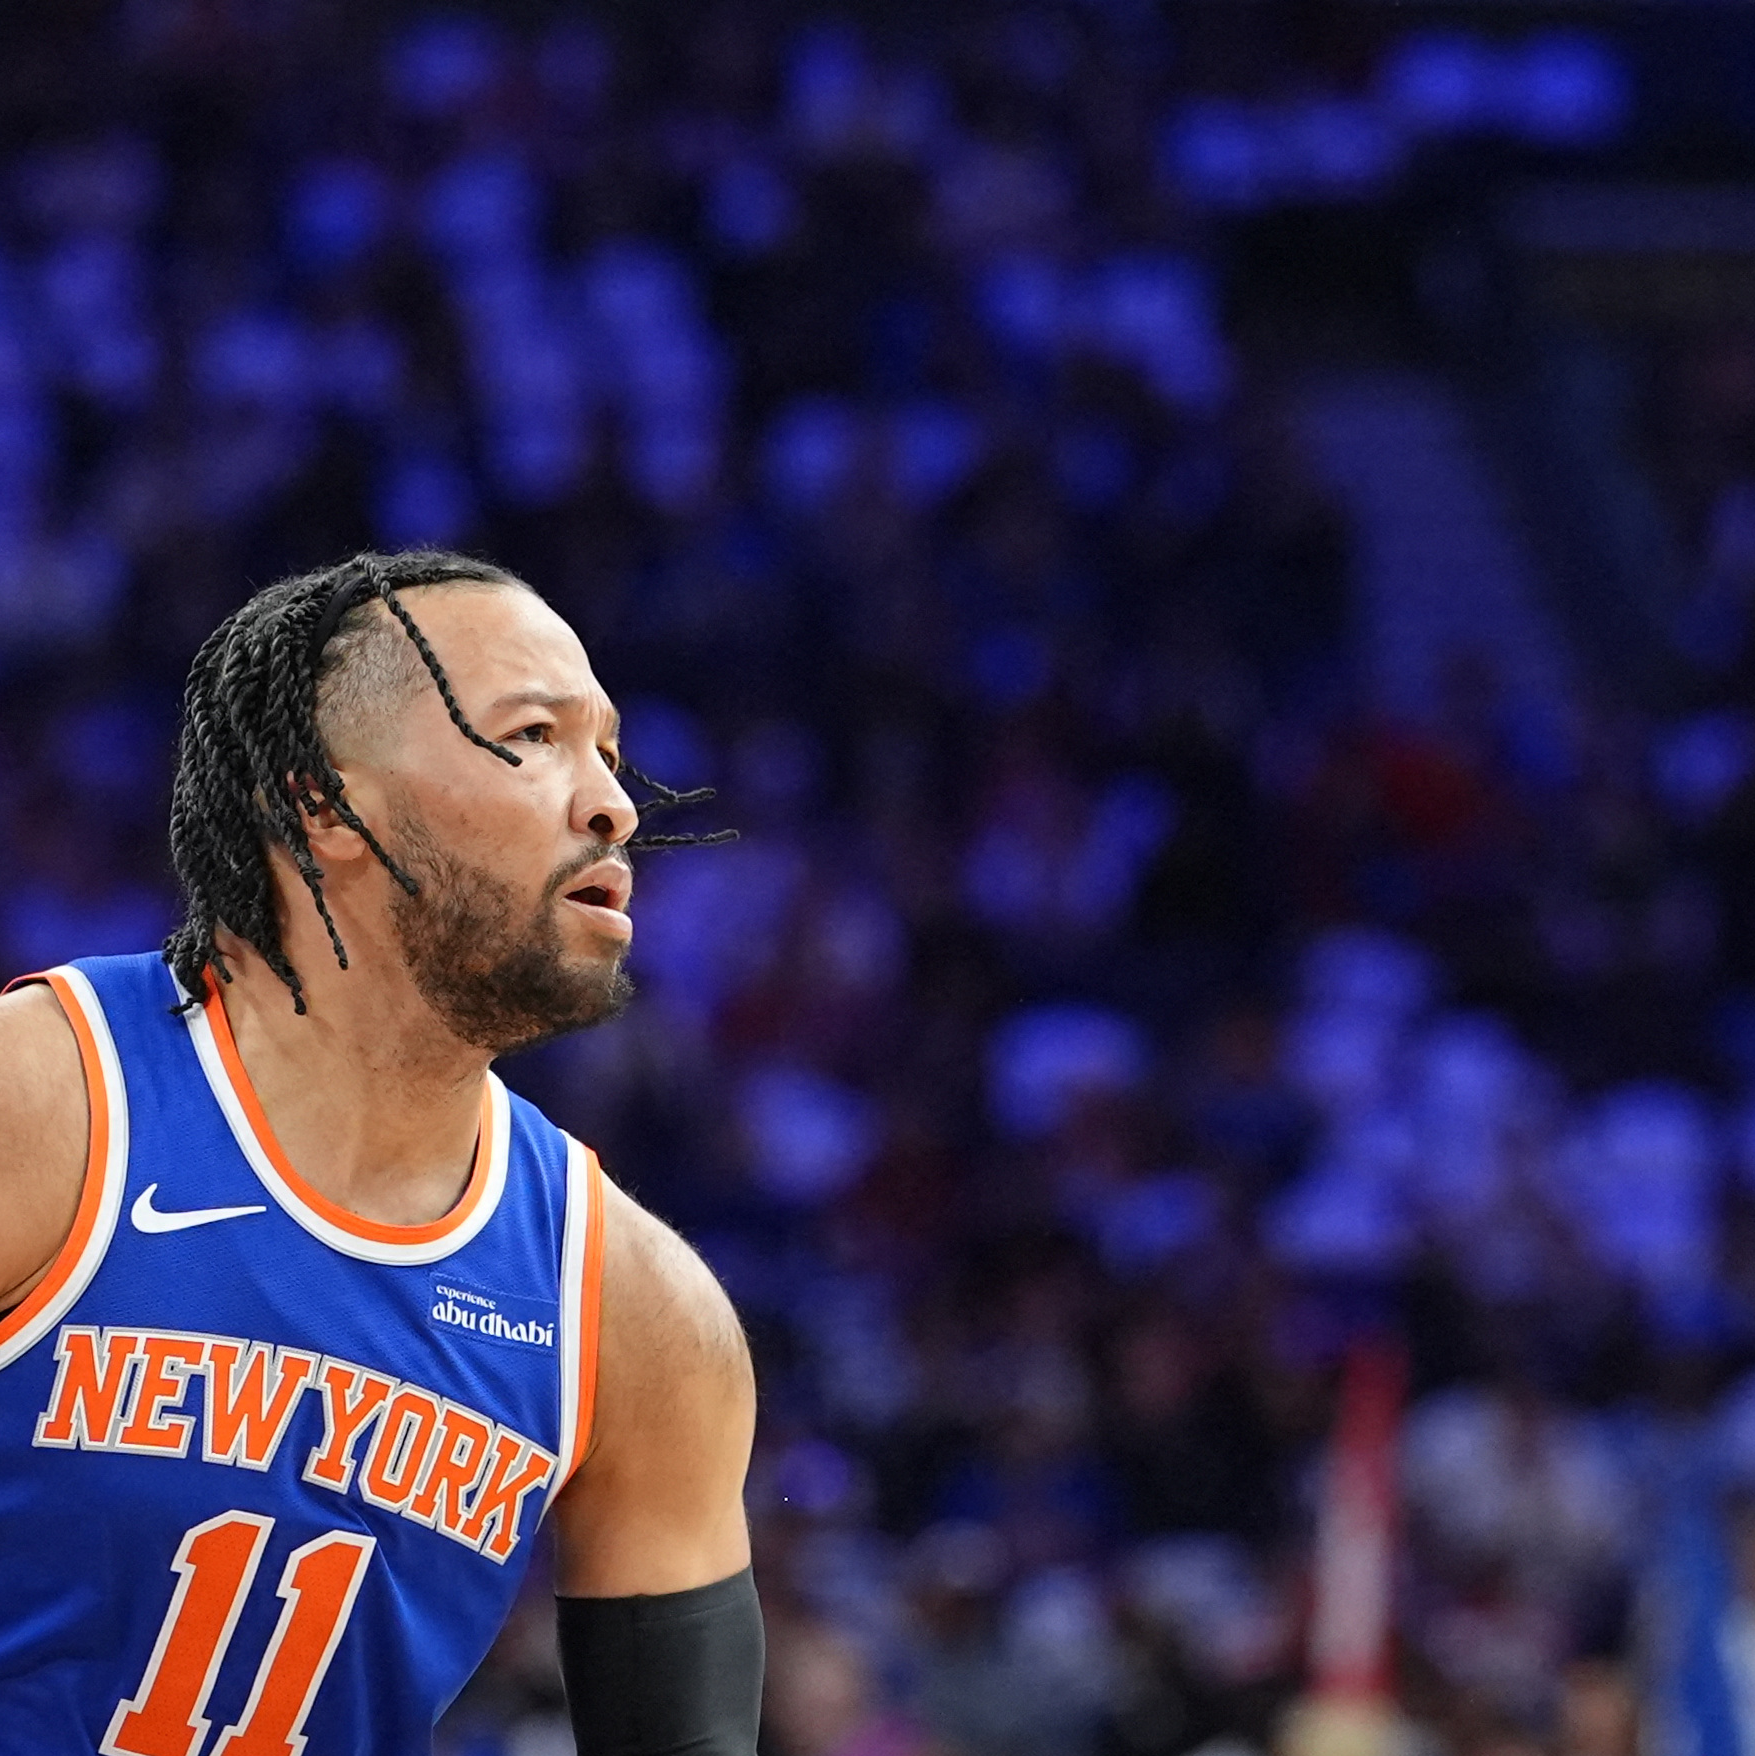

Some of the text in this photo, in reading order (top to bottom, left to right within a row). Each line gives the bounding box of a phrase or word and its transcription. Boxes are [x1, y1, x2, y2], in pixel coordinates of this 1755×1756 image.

[436, 1284, 496, 1309] experience
[432, 1300, 476, 1330] abu
[32, 1325, 559, 1565] NEW YORK
